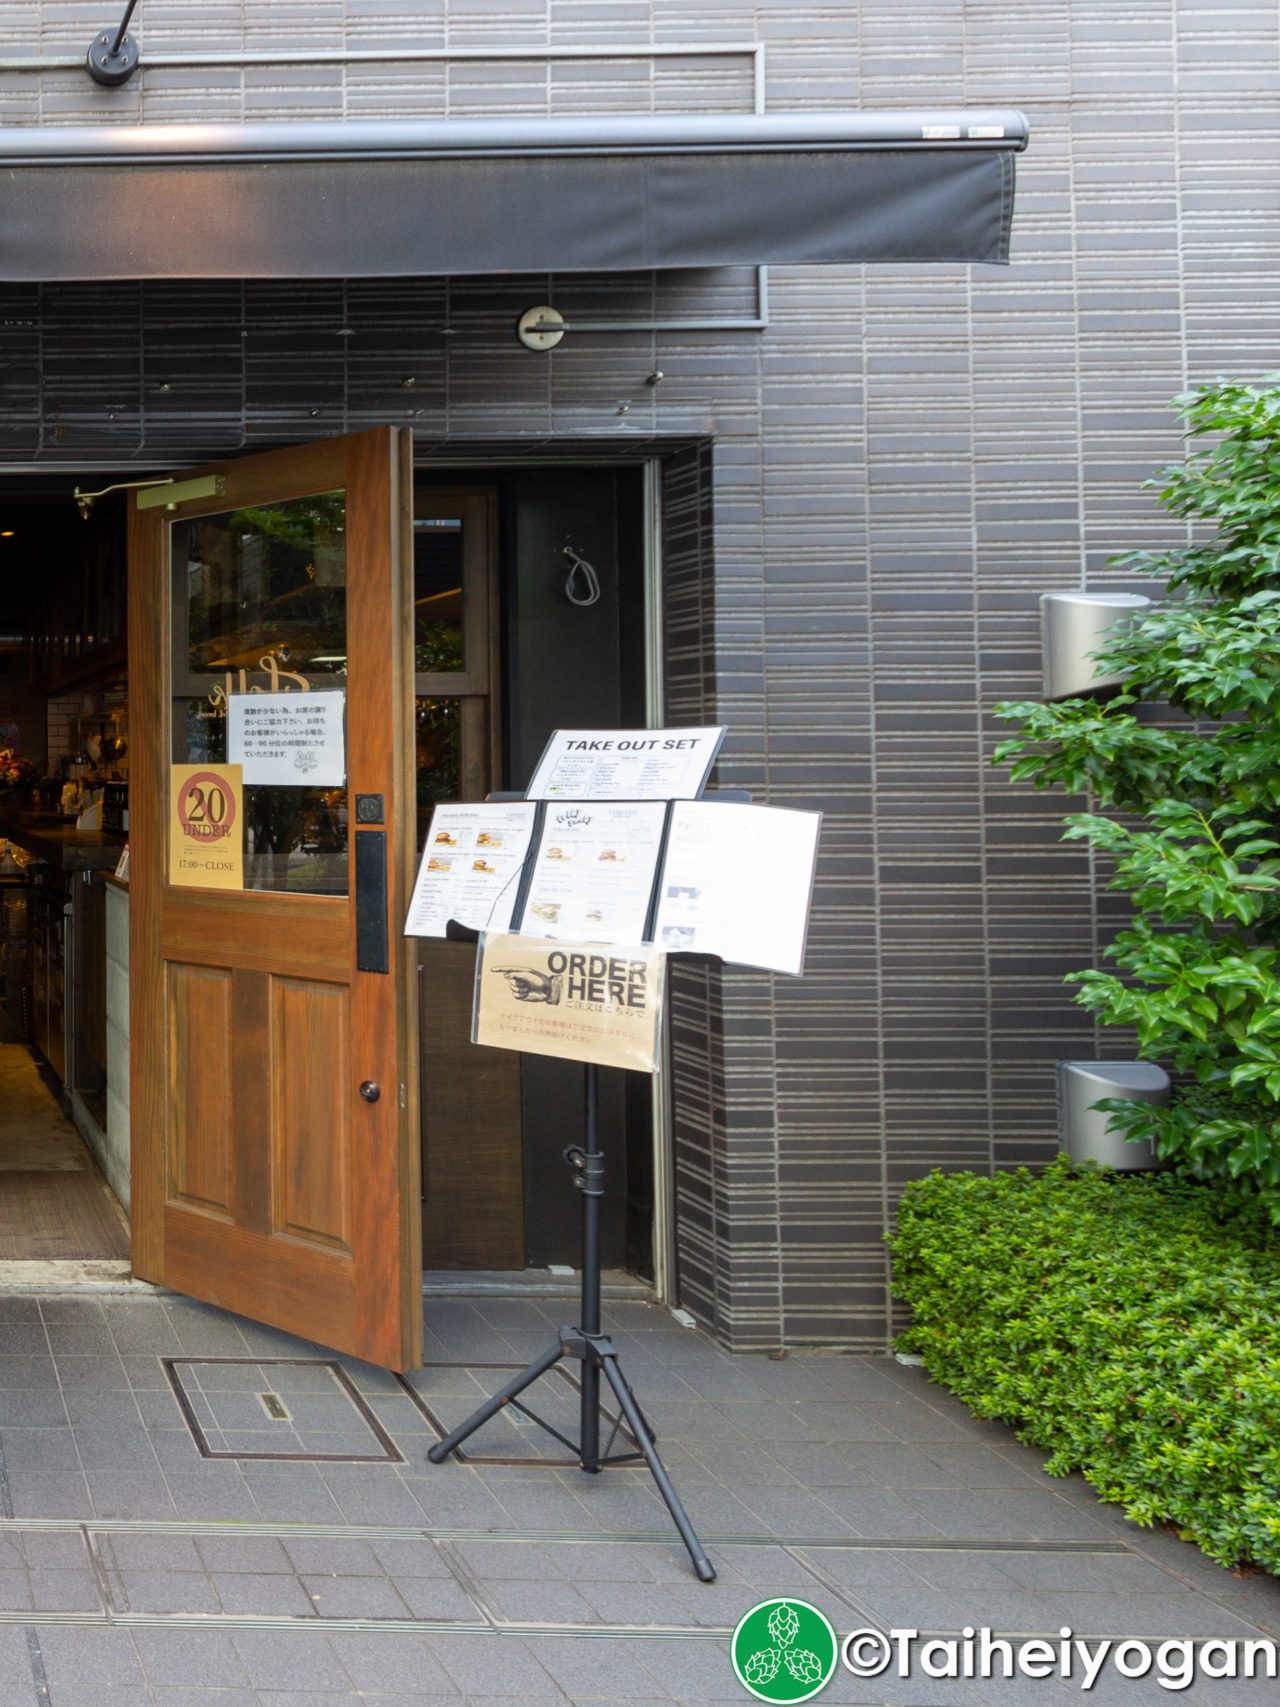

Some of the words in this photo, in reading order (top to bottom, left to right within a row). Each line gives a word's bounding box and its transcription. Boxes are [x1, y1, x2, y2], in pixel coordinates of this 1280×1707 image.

[566, 740, 614, 751] TAKE
[618, 739, 659, 751] OUT
[662, 738, 701, 750] SET
[188, 788, 225, 823] 20
[183, 823, 231, 837] UNDER
[548, 951, 648, 984] ORDER
[567, 977, 647, 1008] HERE
[565, 1000, 646, 1018] ご注文はこちらで
